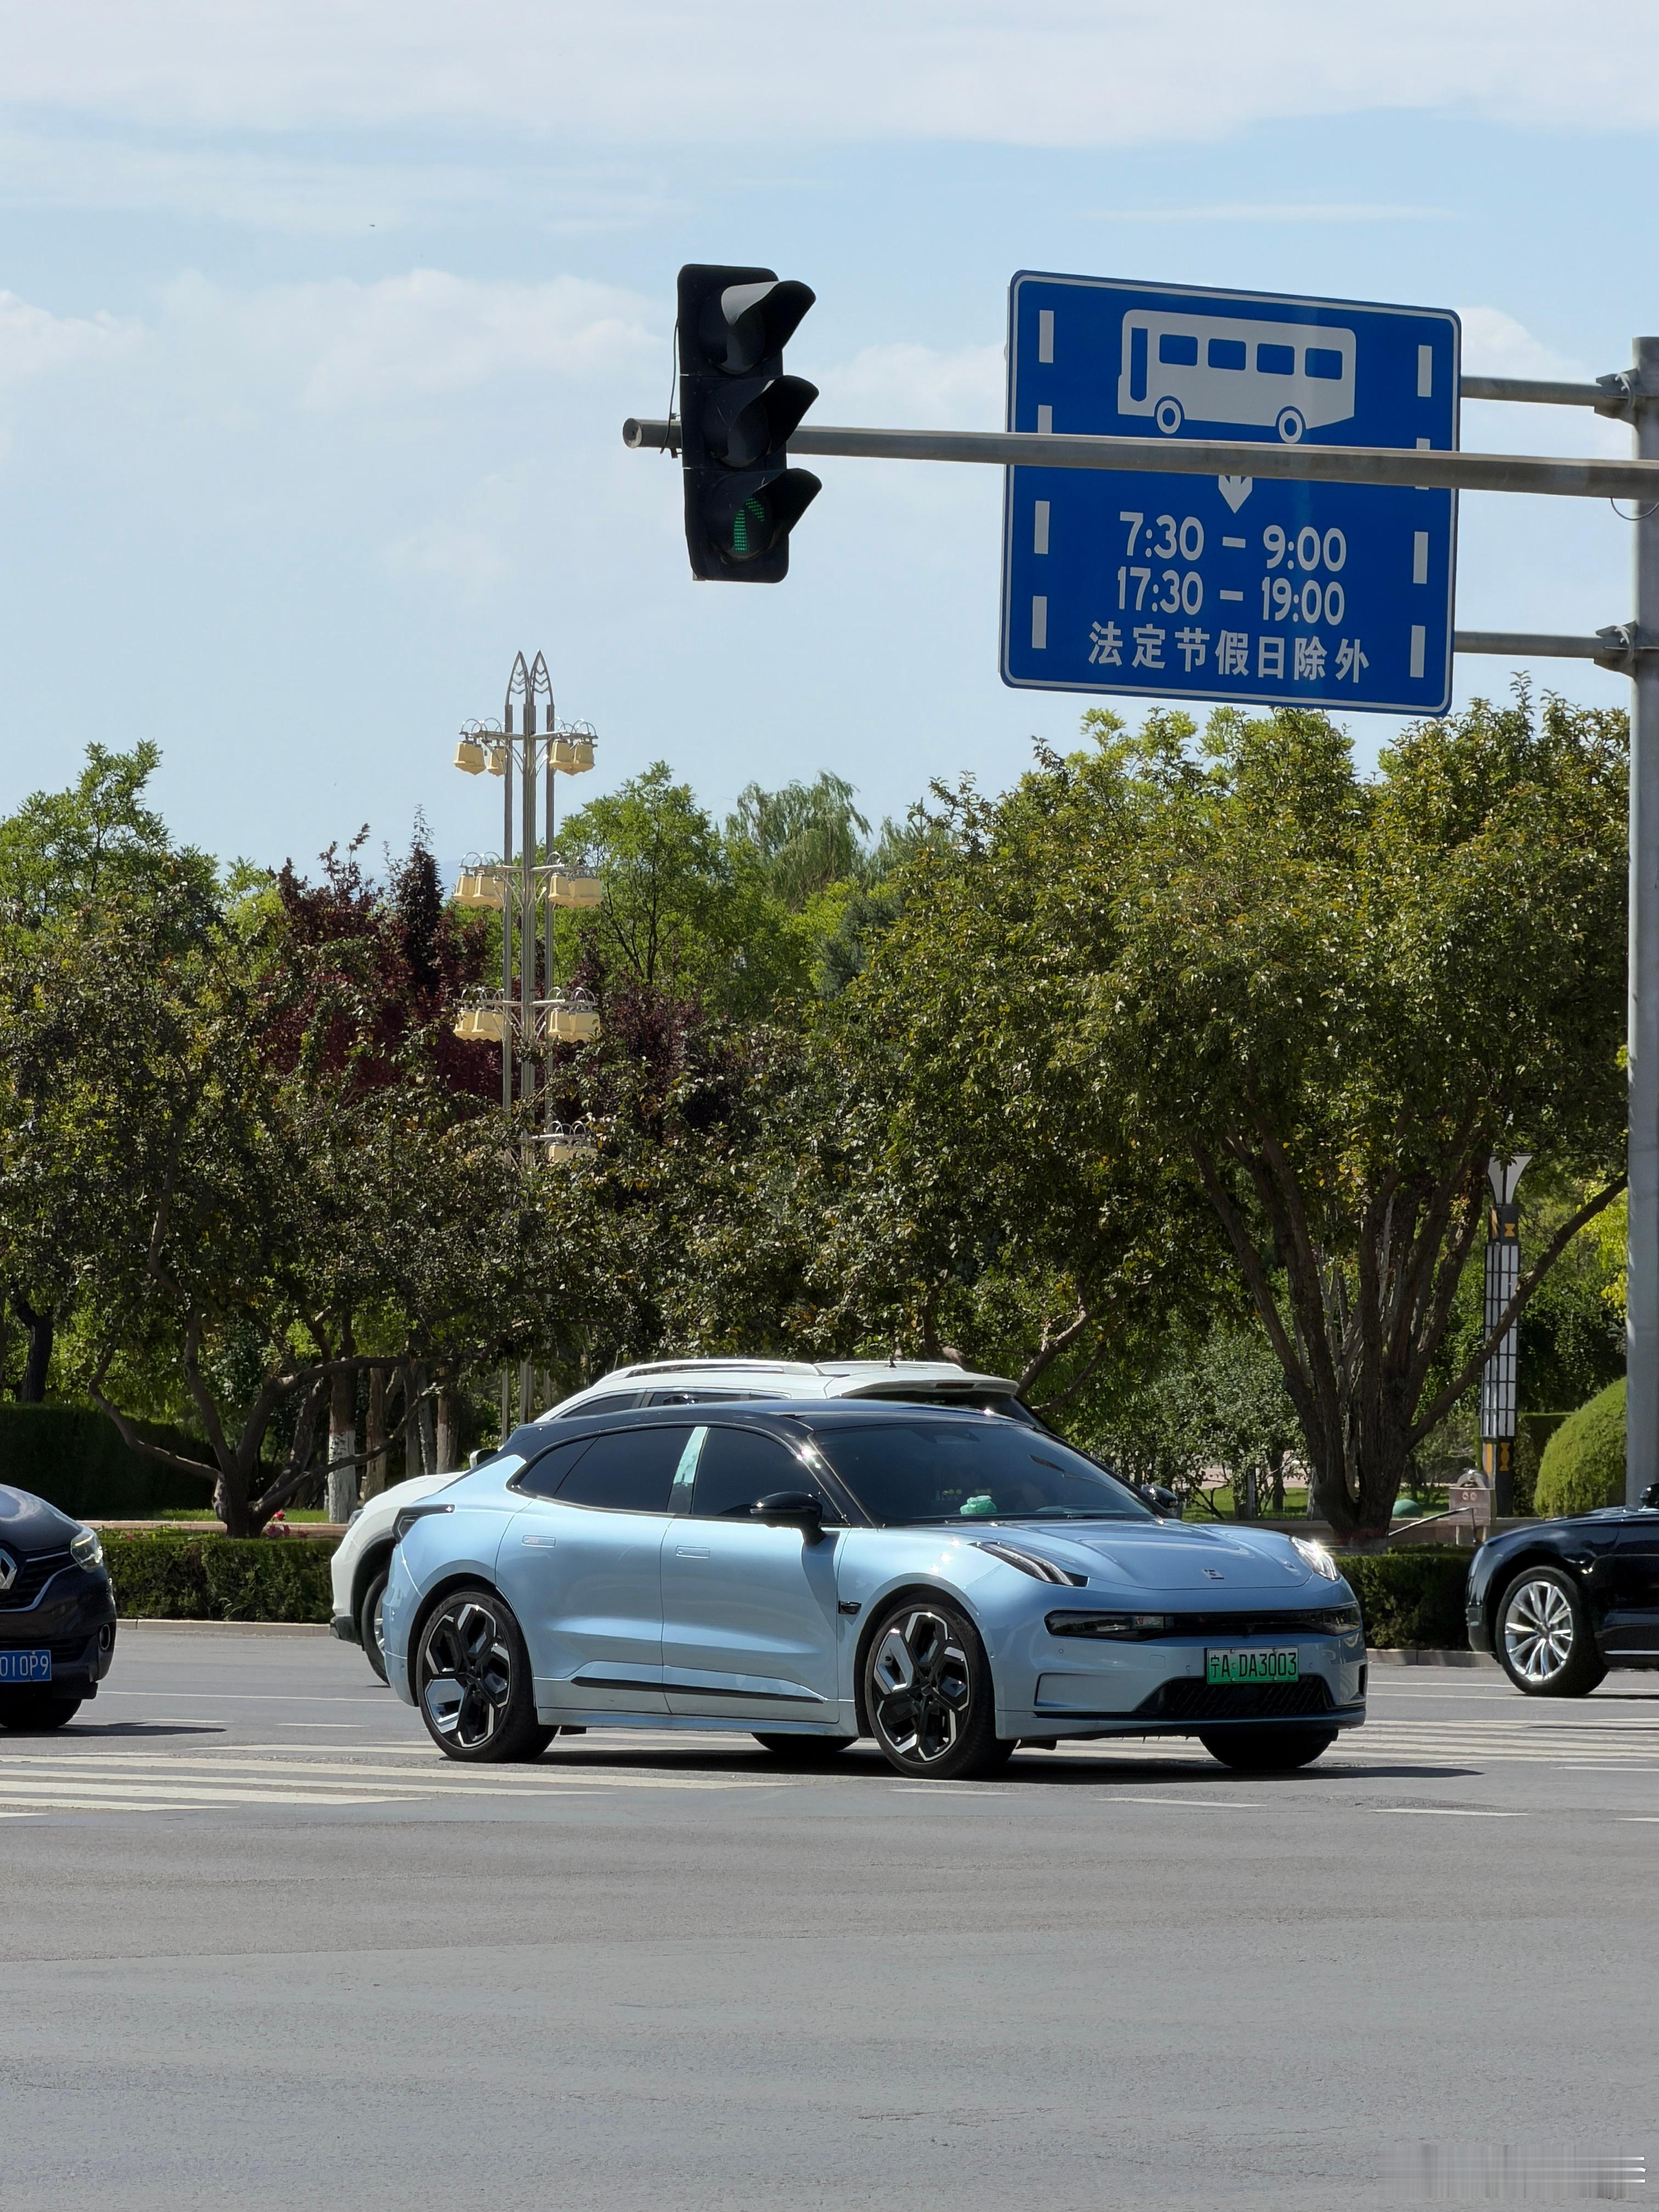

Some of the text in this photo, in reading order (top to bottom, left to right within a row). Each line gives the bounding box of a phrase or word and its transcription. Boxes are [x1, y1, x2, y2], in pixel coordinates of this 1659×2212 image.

[1120, 511, 1204, 561] 7:30
[1263, 524, 1346, 572] 9:00
[1118, 566, 1203, 615] 17:30
[1262, 577, 1345, 625] 19:00
[1088, 621, 1369, 683] 法定节假日除外
